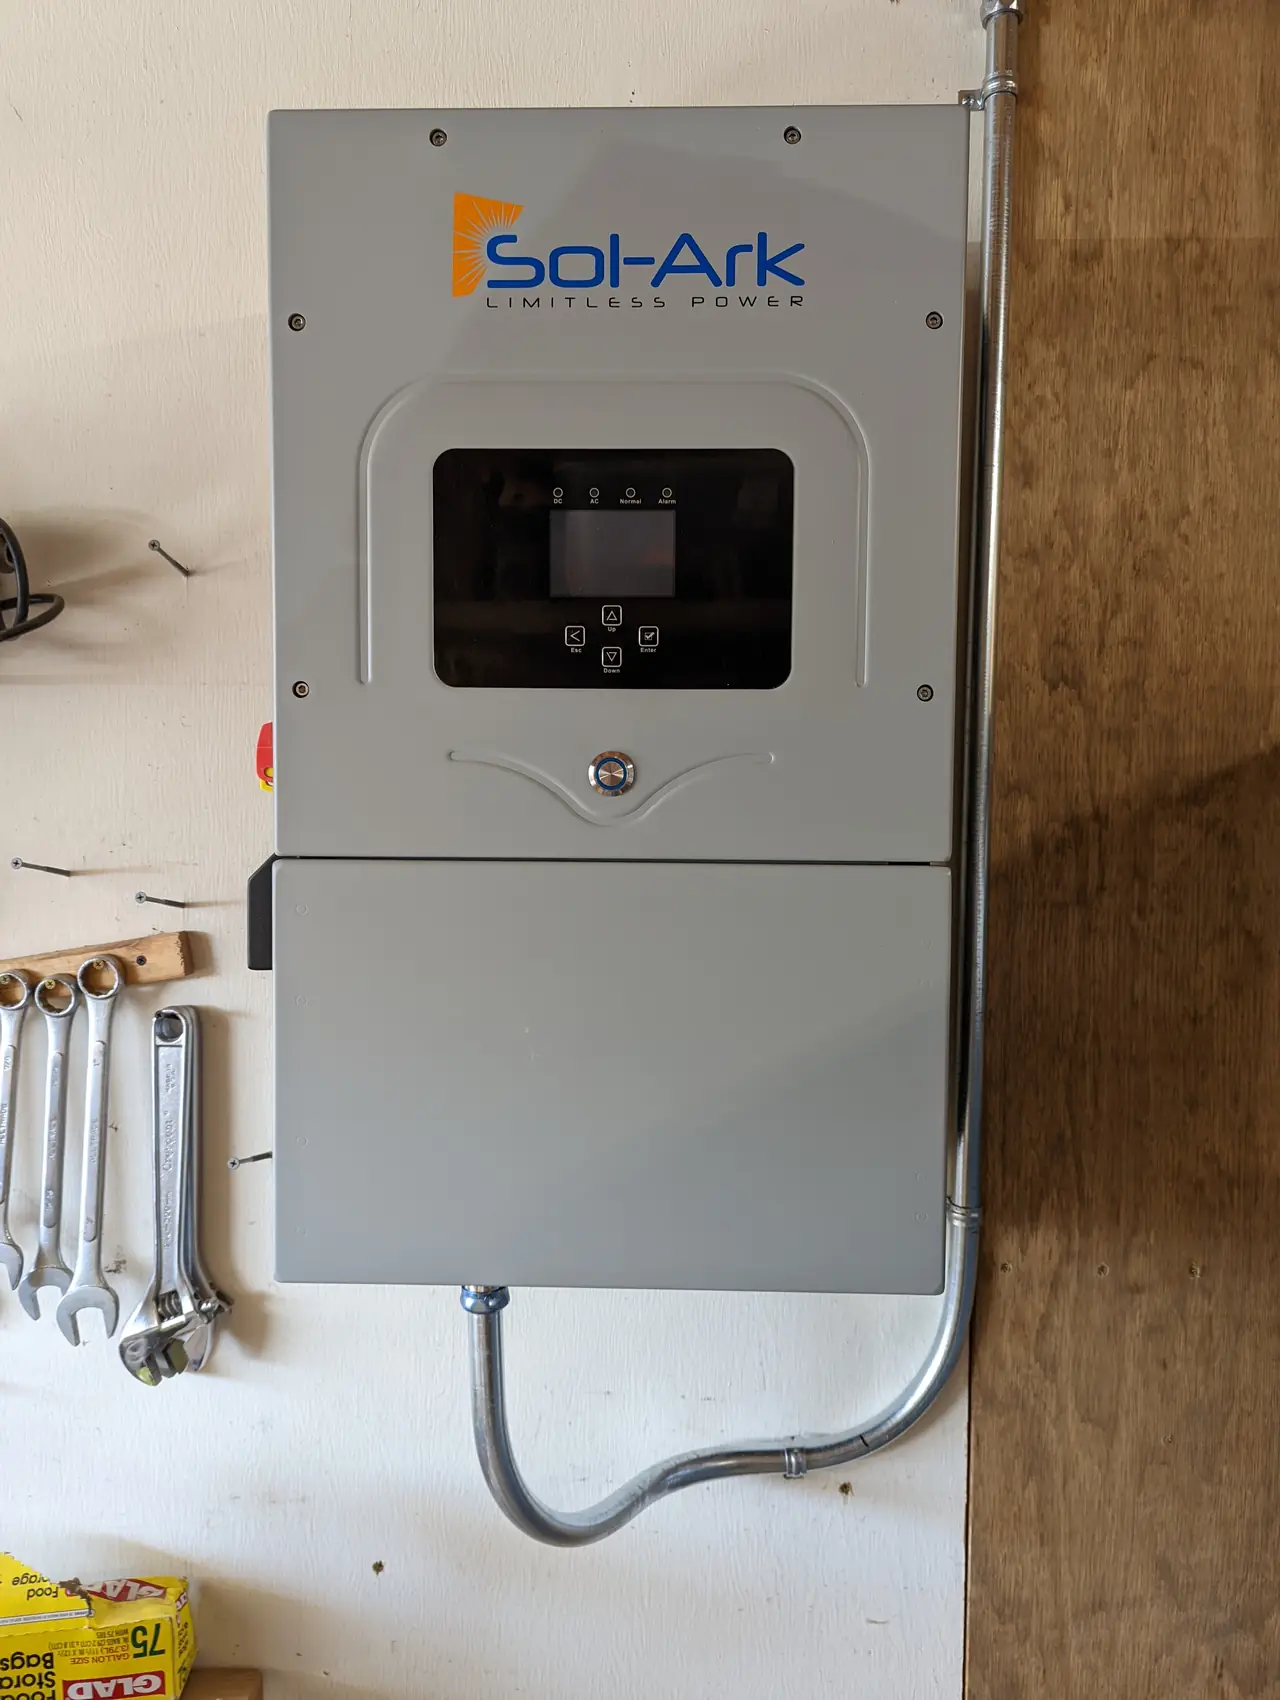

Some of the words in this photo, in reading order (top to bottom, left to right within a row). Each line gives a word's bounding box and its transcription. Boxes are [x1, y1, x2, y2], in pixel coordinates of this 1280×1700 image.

[486, 232, 805, 288] Sol-Ark
[486, 296, 666, 308] LIMITLESS
[691, 295, 804, 308] POWER
[27, 1587, 58, 1600] Food
[131, 1623, 165, 1659] 75
[0, 1652, 54, 1671] Bags
[70, 1657, 90, 1665] SIZE
[91, 1652, 130, 1663] GALLON
[67, 1674, 162, 1700] GLAD
